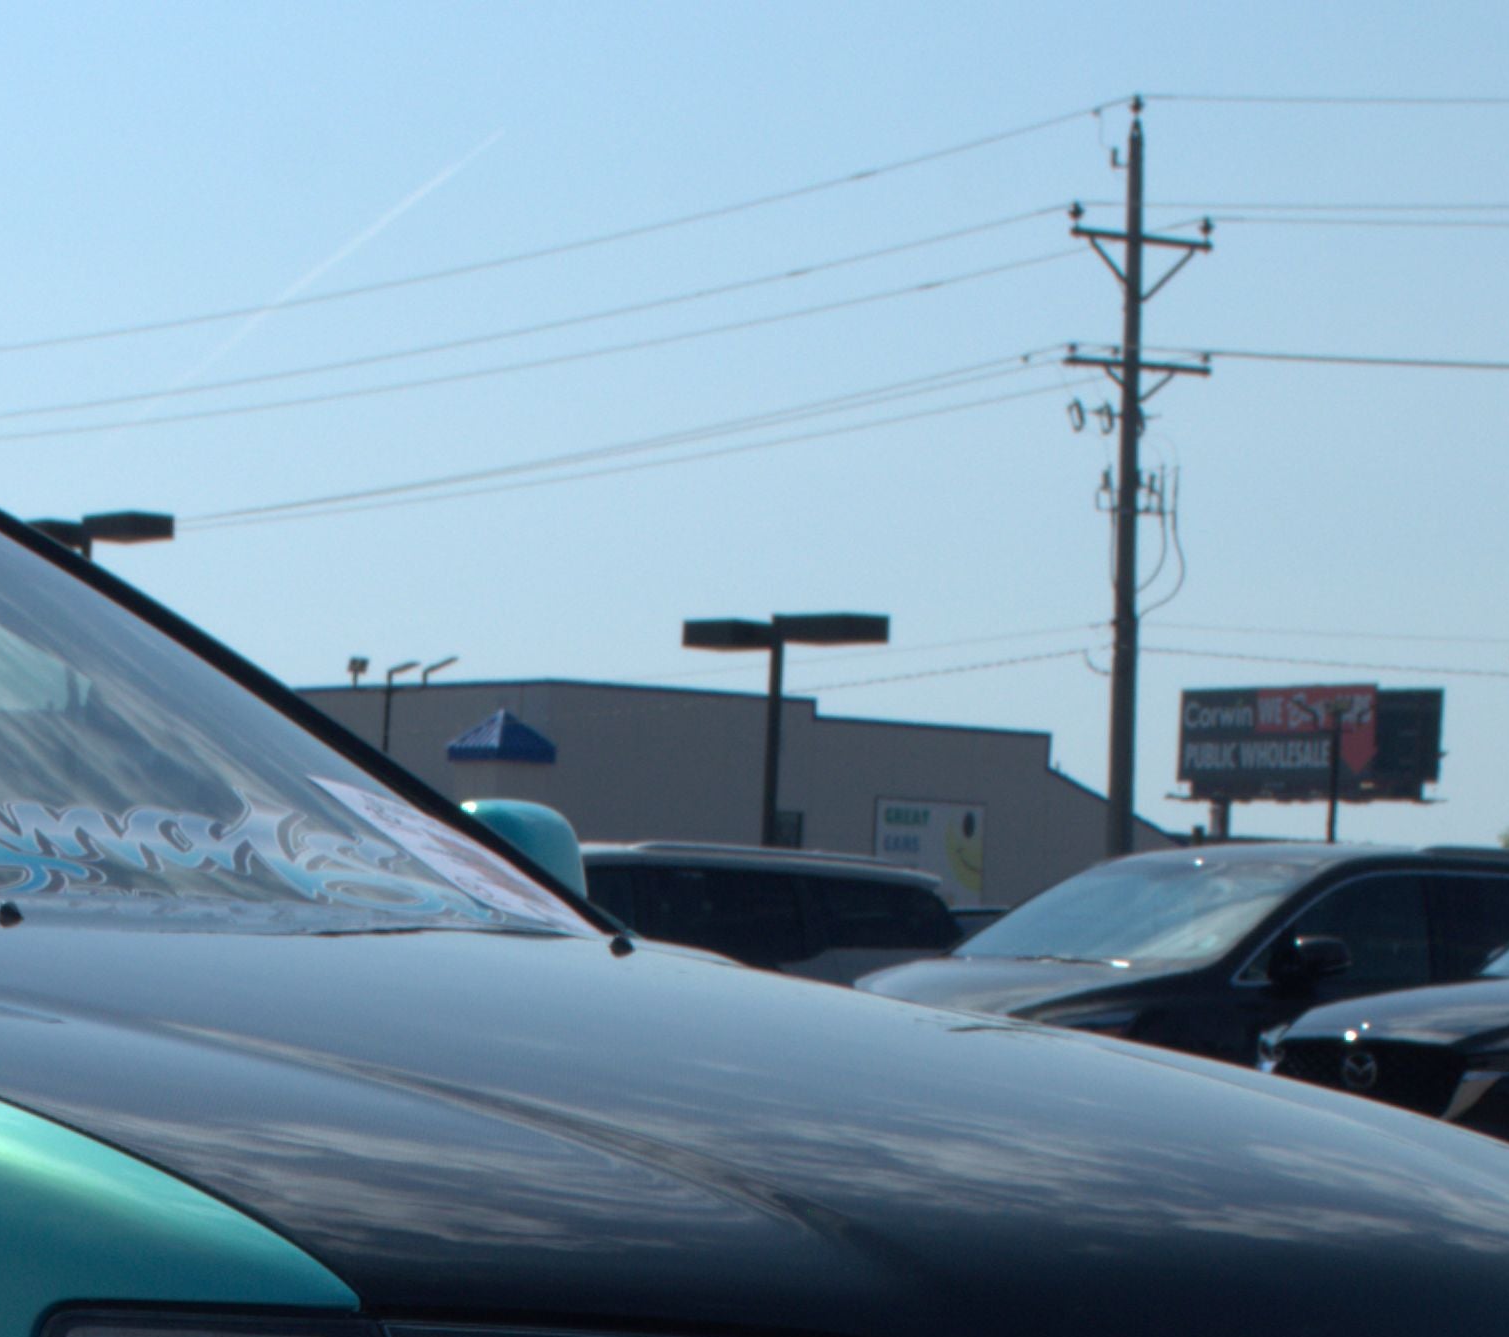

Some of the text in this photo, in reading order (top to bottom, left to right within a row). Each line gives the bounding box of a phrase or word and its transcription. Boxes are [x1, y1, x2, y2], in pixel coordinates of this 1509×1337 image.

[1185, 700, 1253, 728] Corwin
[1184, 739, 1331, 770] PUBLIC WHOLESALE
